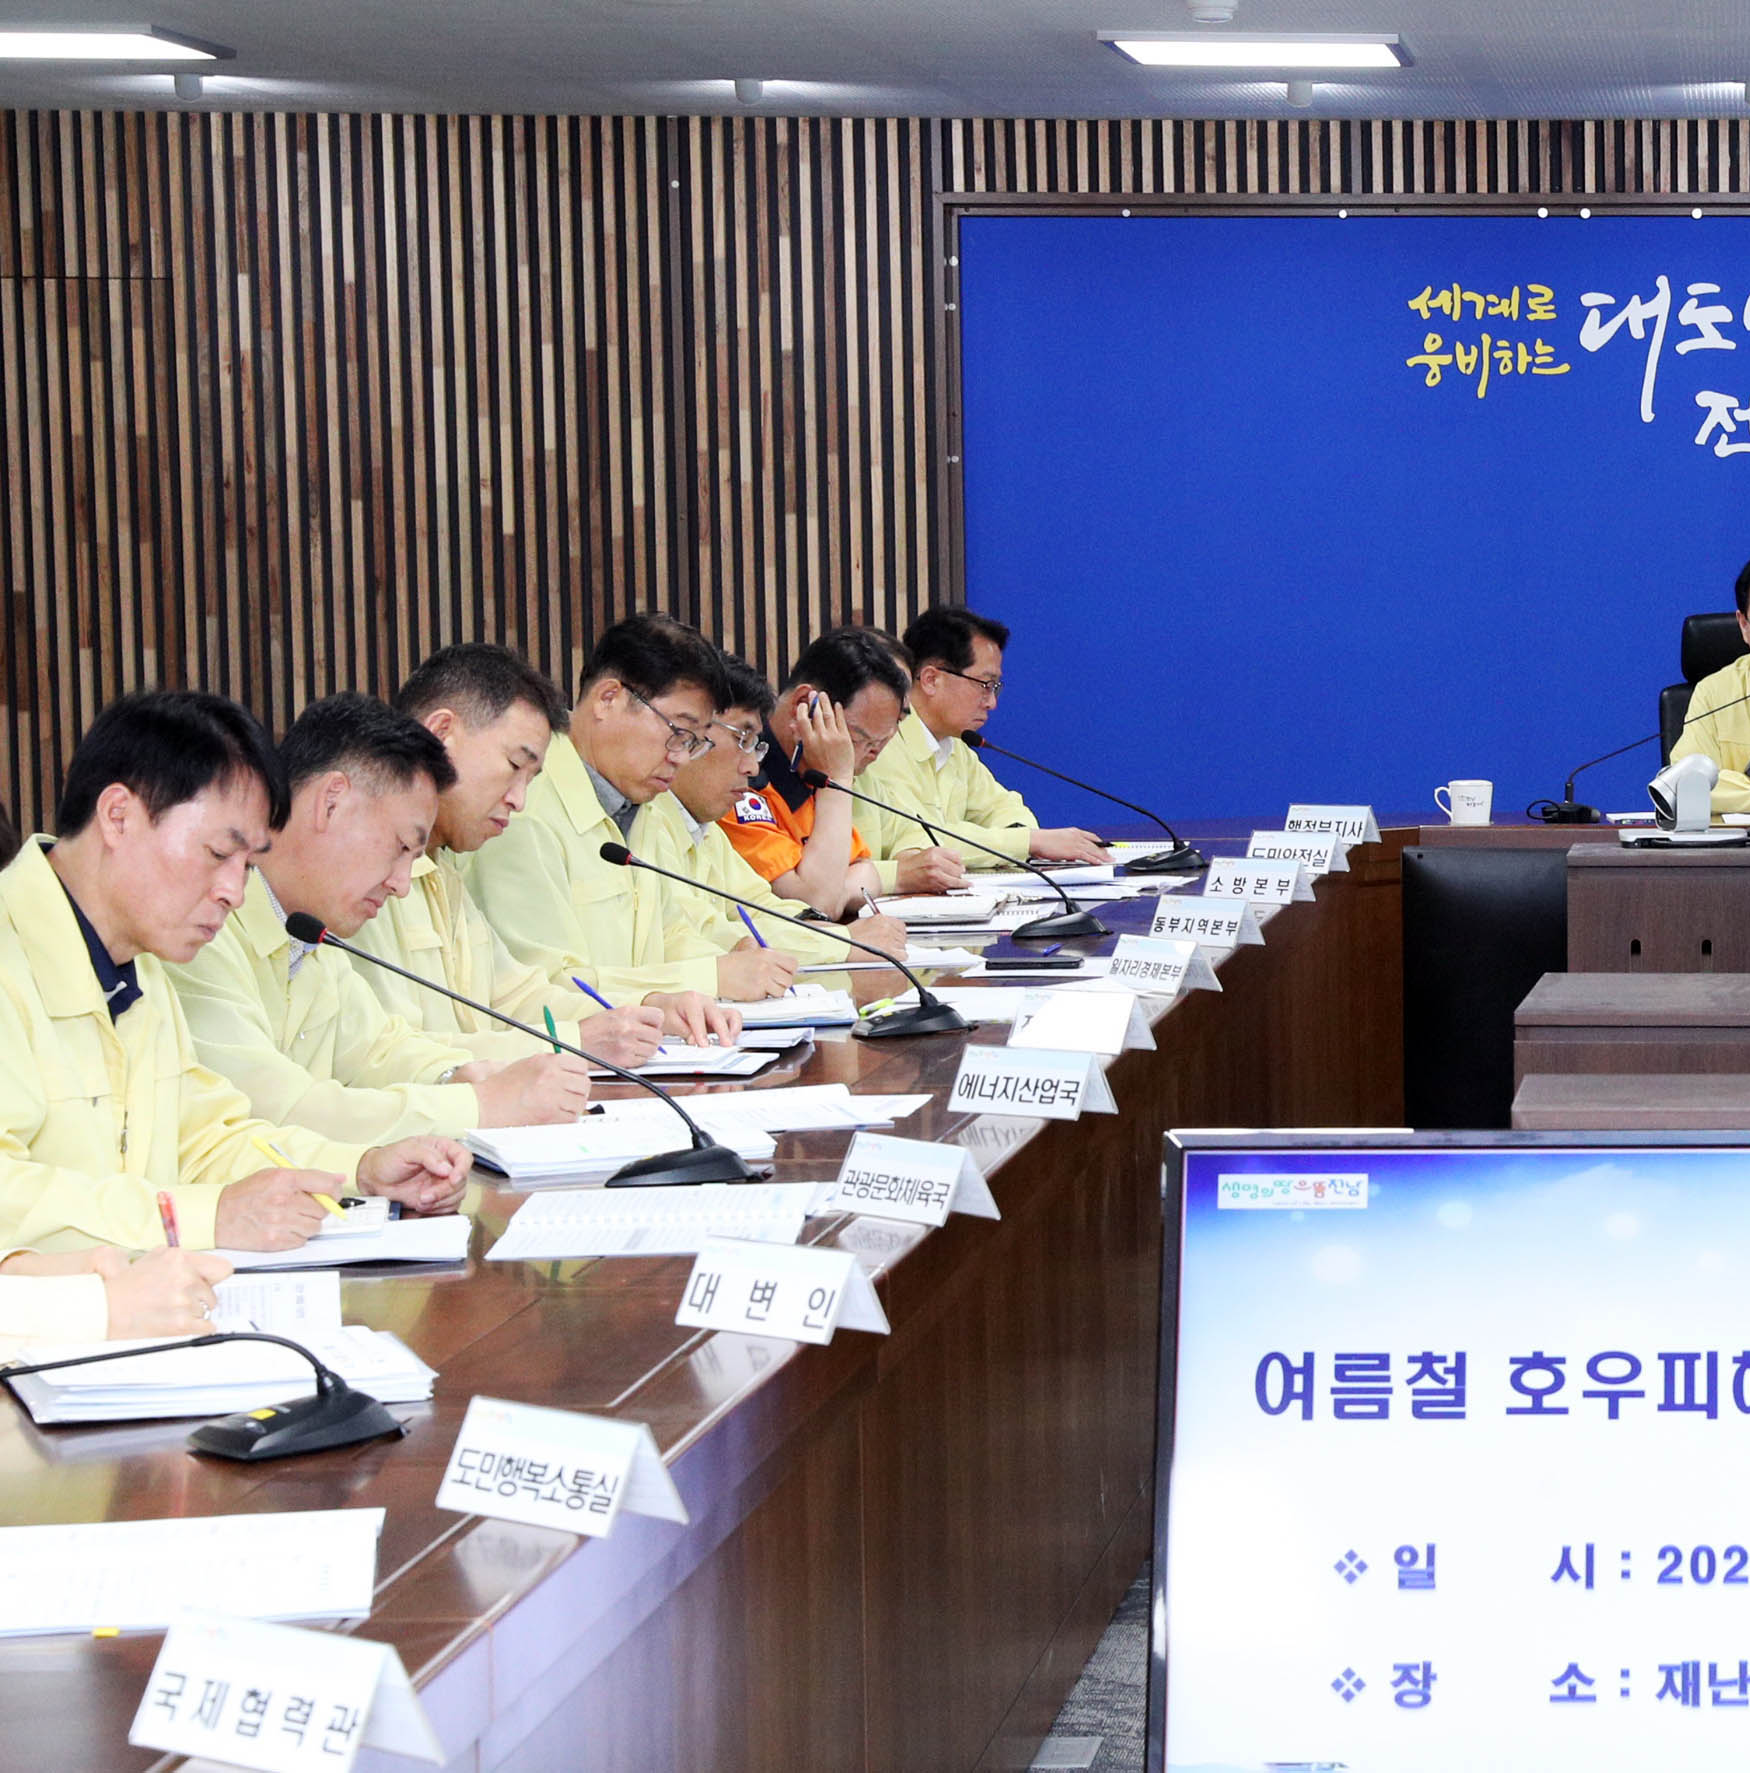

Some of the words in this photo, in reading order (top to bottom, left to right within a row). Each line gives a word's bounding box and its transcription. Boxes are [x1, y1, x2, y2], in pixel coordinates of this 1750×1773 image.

[1407, 283, 1557, 322] 세계로
[1405, 333, 1571, 398] 웅비하는
[1153, 916, 1239, 937] 동부지역본부
[1109, 958, 1184, 981] 일자리경제본부
[958, 1072, 1081, 1107] 에너지산업국
[841, 1169, 951, 1211] 관광문화체육국
[1255, 1351, 1467, 1420] 여름철
[451, 1447, 619, 1515] 도민행복소통실
